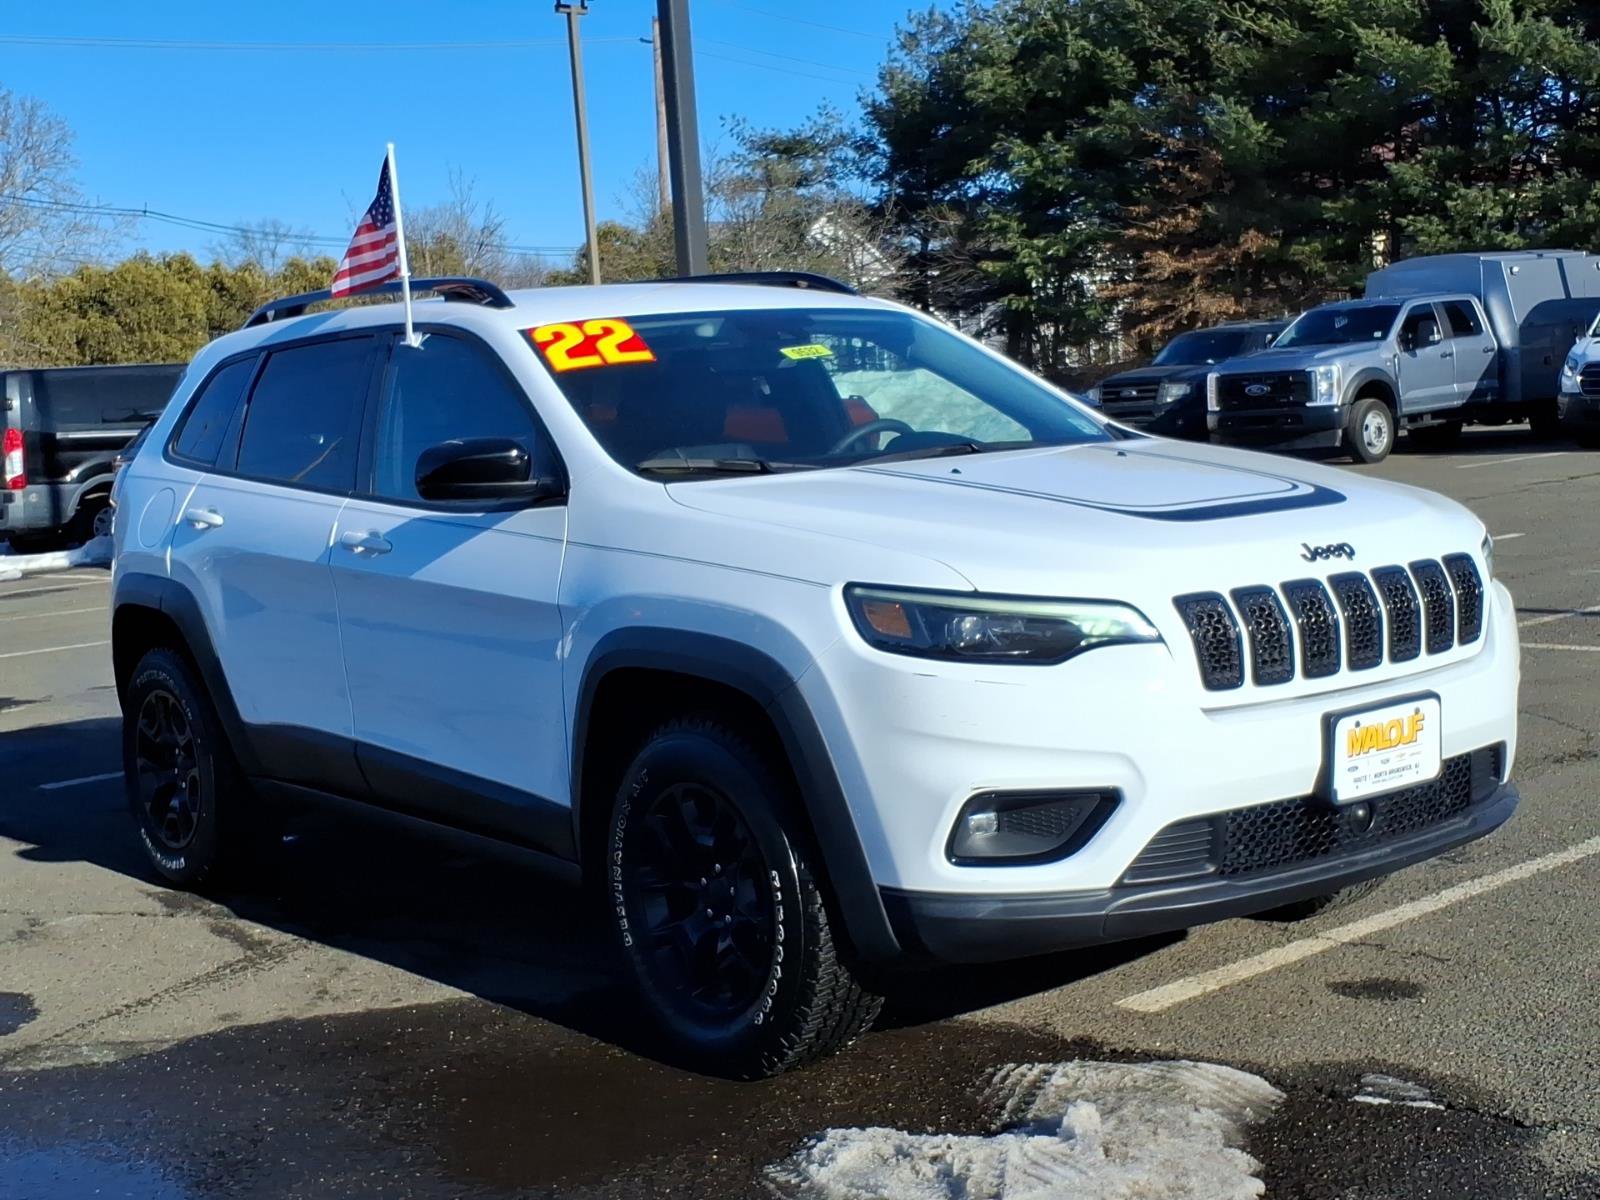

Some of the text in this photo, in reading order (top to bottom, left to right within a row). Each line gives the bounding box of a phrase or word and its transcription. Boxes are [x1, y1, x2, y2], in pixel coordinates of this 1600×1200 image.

[530, 319, 656, 371] 22
[1300, 542, 1356, 562] Jeep
[1347, 713, 1425, 758] MALOUF
